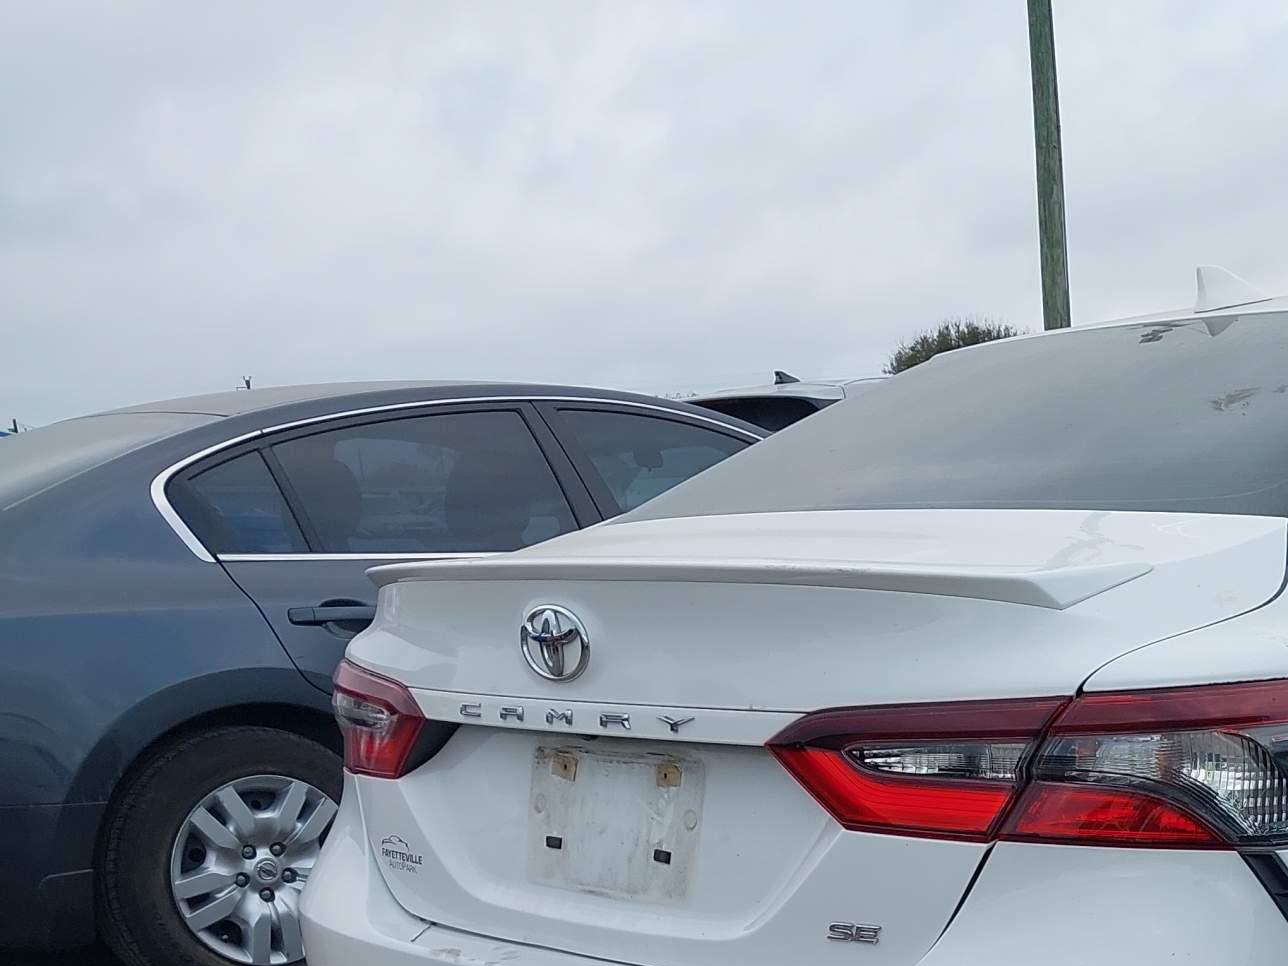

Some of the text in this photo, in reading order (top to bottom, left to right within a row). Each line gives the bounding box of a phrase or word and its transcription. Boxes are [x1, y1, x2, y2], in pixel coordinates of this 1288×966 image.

[459, 703, 695, 733] CAMRY
[381, 847, 423, 865] FAYETTEVILLE
[827, 921, 882, 945] SE
